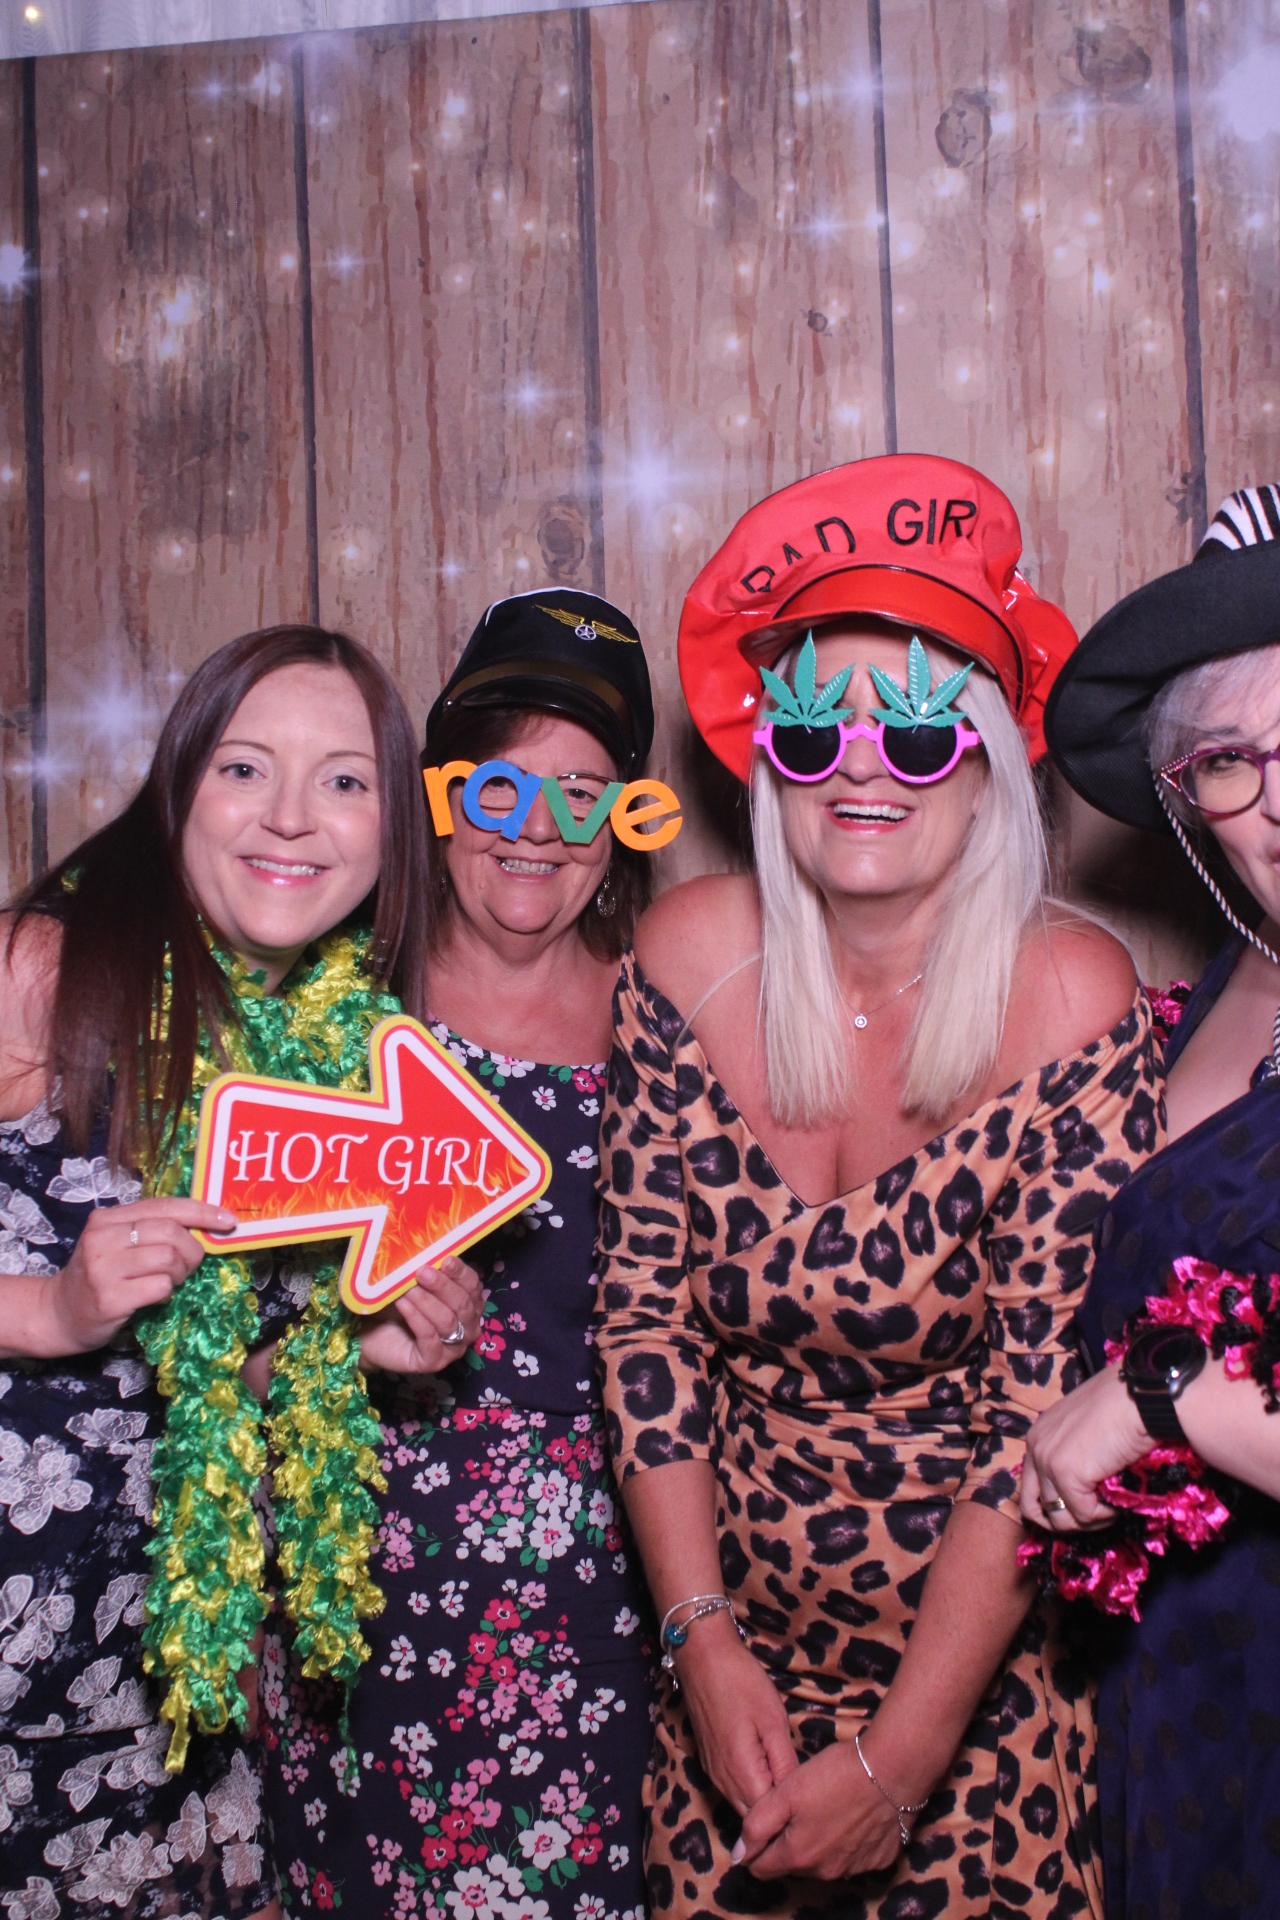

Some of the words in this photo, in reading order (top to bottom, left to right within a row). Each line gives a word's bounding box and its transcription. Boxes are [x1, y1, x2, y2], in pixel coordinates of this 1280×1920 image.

[423, 760, 683, 851] rave
[229, 1130, 368, 1183] HOT
[377, 1136, 499, 1196] GIRL
